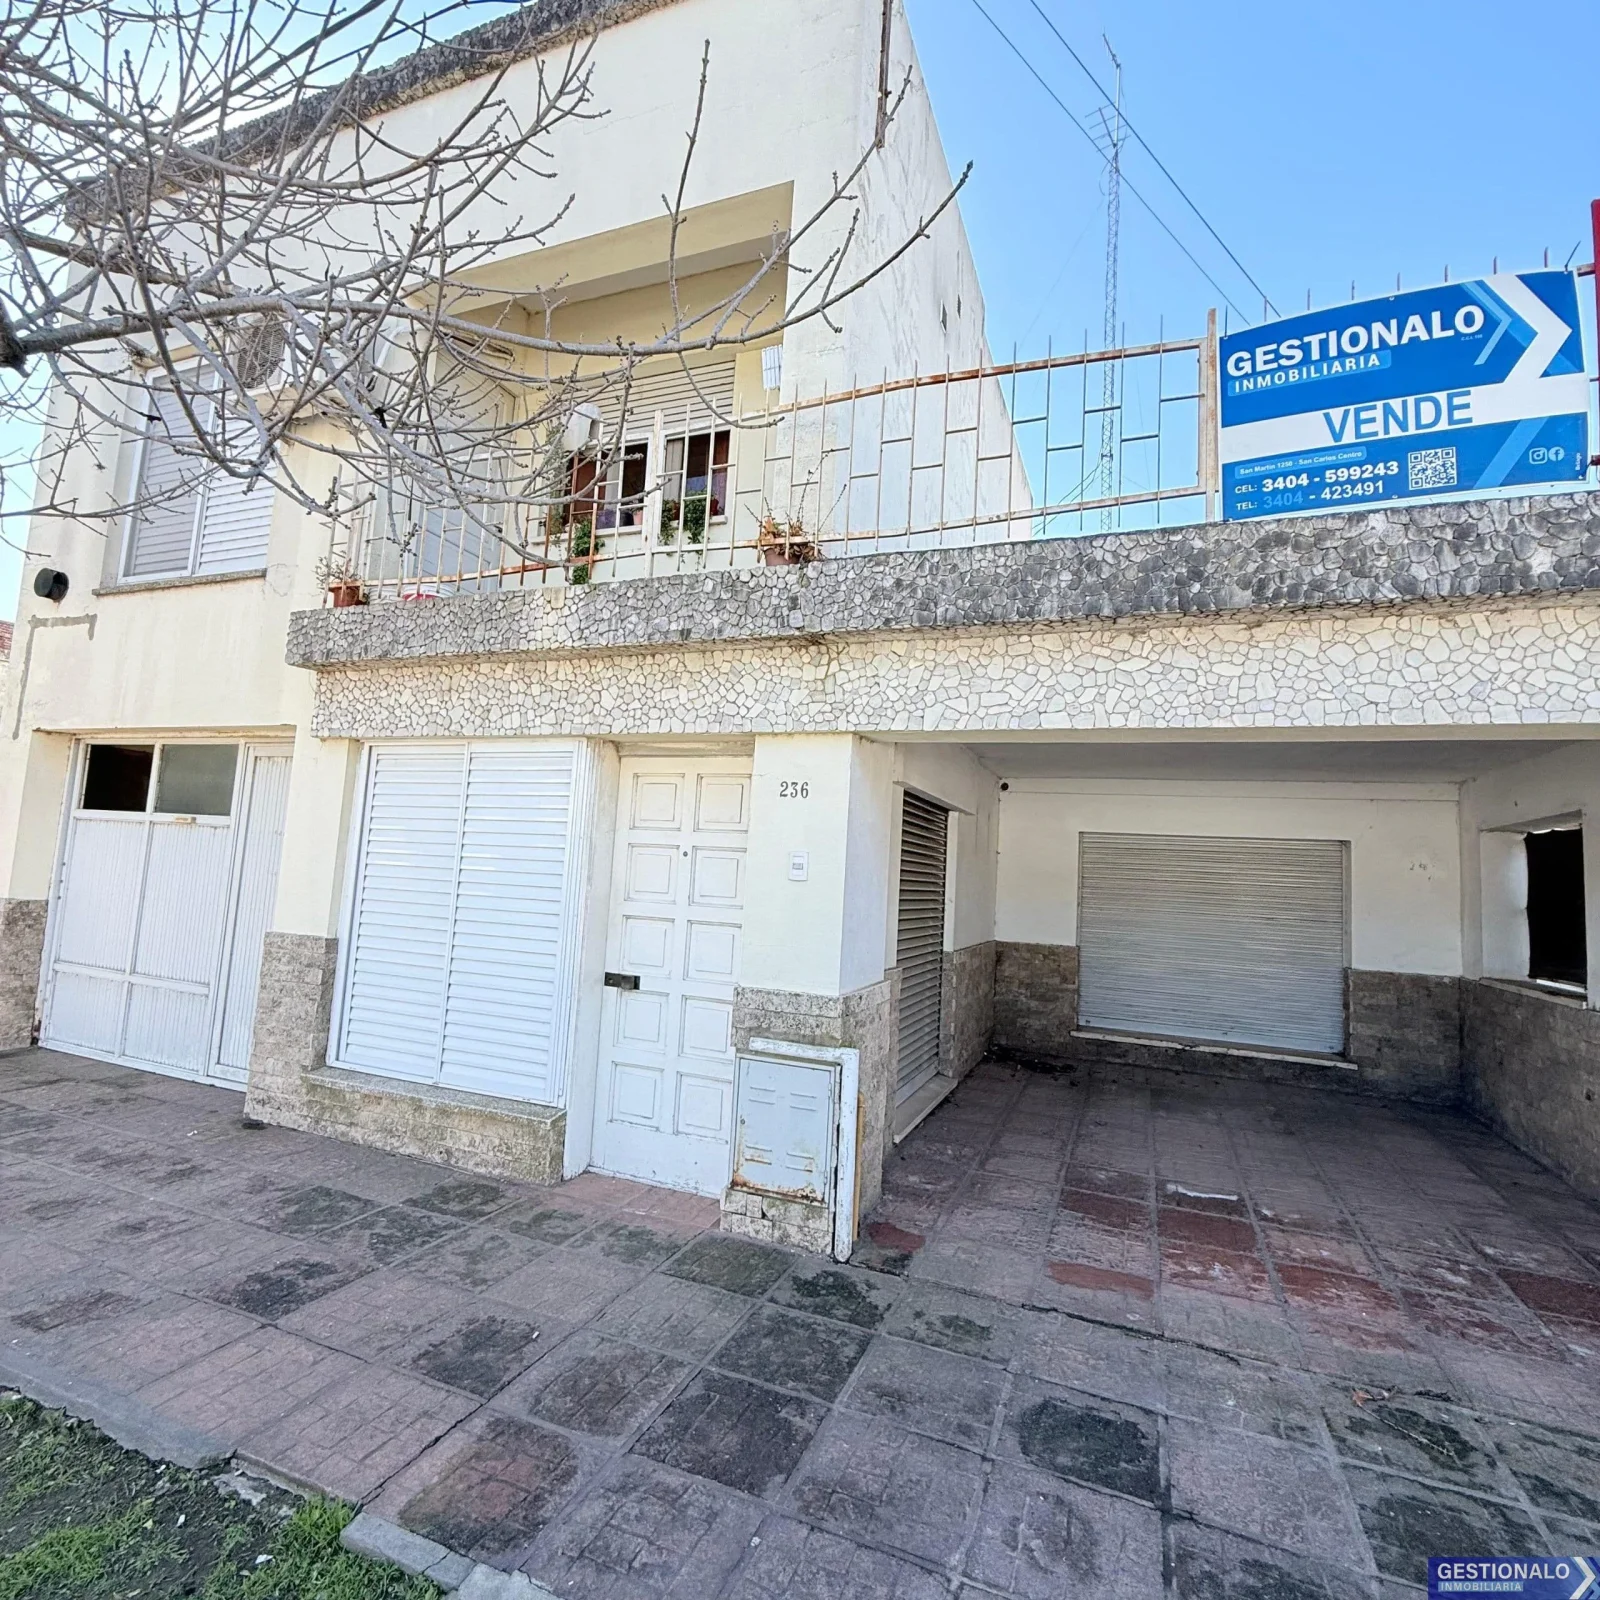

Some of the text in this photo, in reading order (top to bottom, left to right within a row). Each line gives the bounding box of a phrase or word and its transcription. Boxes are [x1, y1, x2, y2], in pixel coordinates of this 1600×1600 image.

[1226, 304, 1485, 378] GESTIONALO
[1234, 353, 1381, 393] INMOBILIARIA
[1322, 389, 1474, 443] VENDE
[1234, 484, 1258, 494] CEL:
[1261, 472, 1310, 493] 3404
[1324, 460, 1399, 483] 599243
[1239, 467, 1253, 475] San
[1298, 457, 1312, 465] San
[1313, 455, 1337, 463] Carlos
[1338, 450, 1363, 460] Centro
[1235, 500, 1258, 511] TEL:
[1263, 490, 1304, 509] 3404
[1320, 480, 1384, 500] 423491
[779, 780, 809, 799] 236
